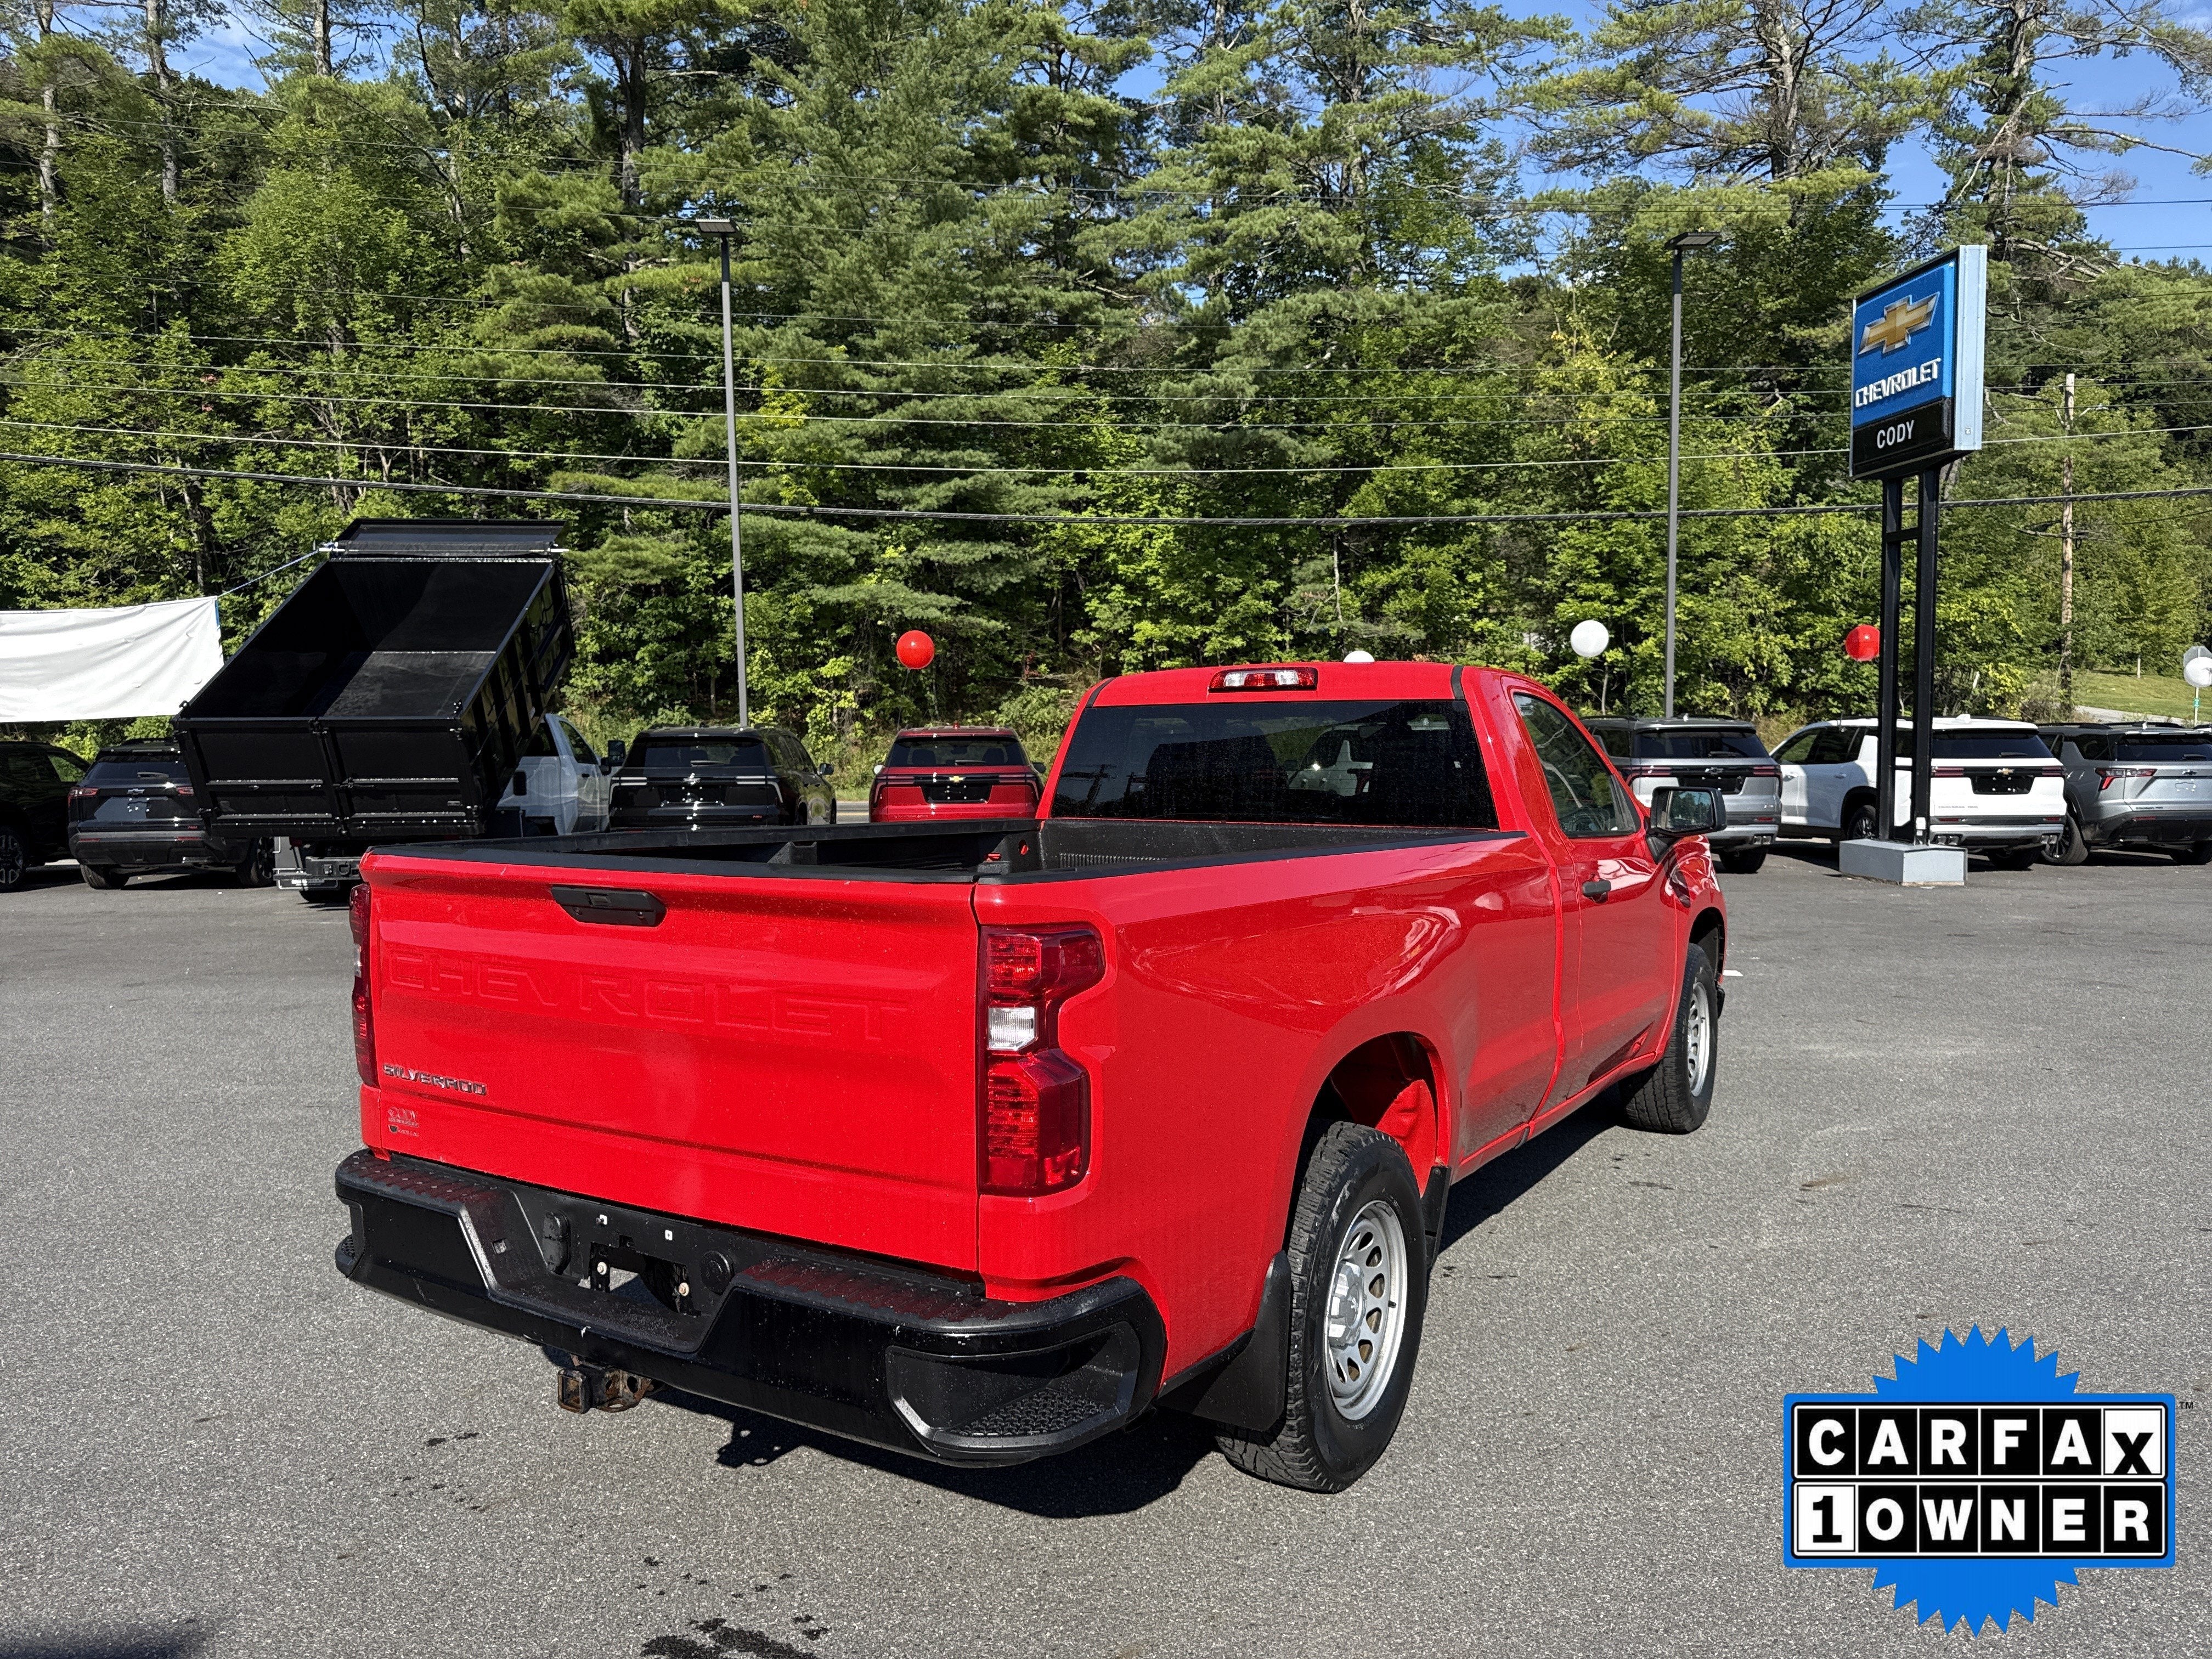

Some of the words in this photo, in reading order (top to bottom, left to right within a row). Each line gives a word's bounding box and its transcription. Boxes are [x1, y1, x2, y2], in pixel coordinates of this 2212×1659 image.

[1855, 357, 1942, 408] CHEVROLET
[1877, 420, 1915, 449] CODY
[390, 950, 909, 1040] CHEVROLET
[383, 1063, 487, 1096] SILVERADO
